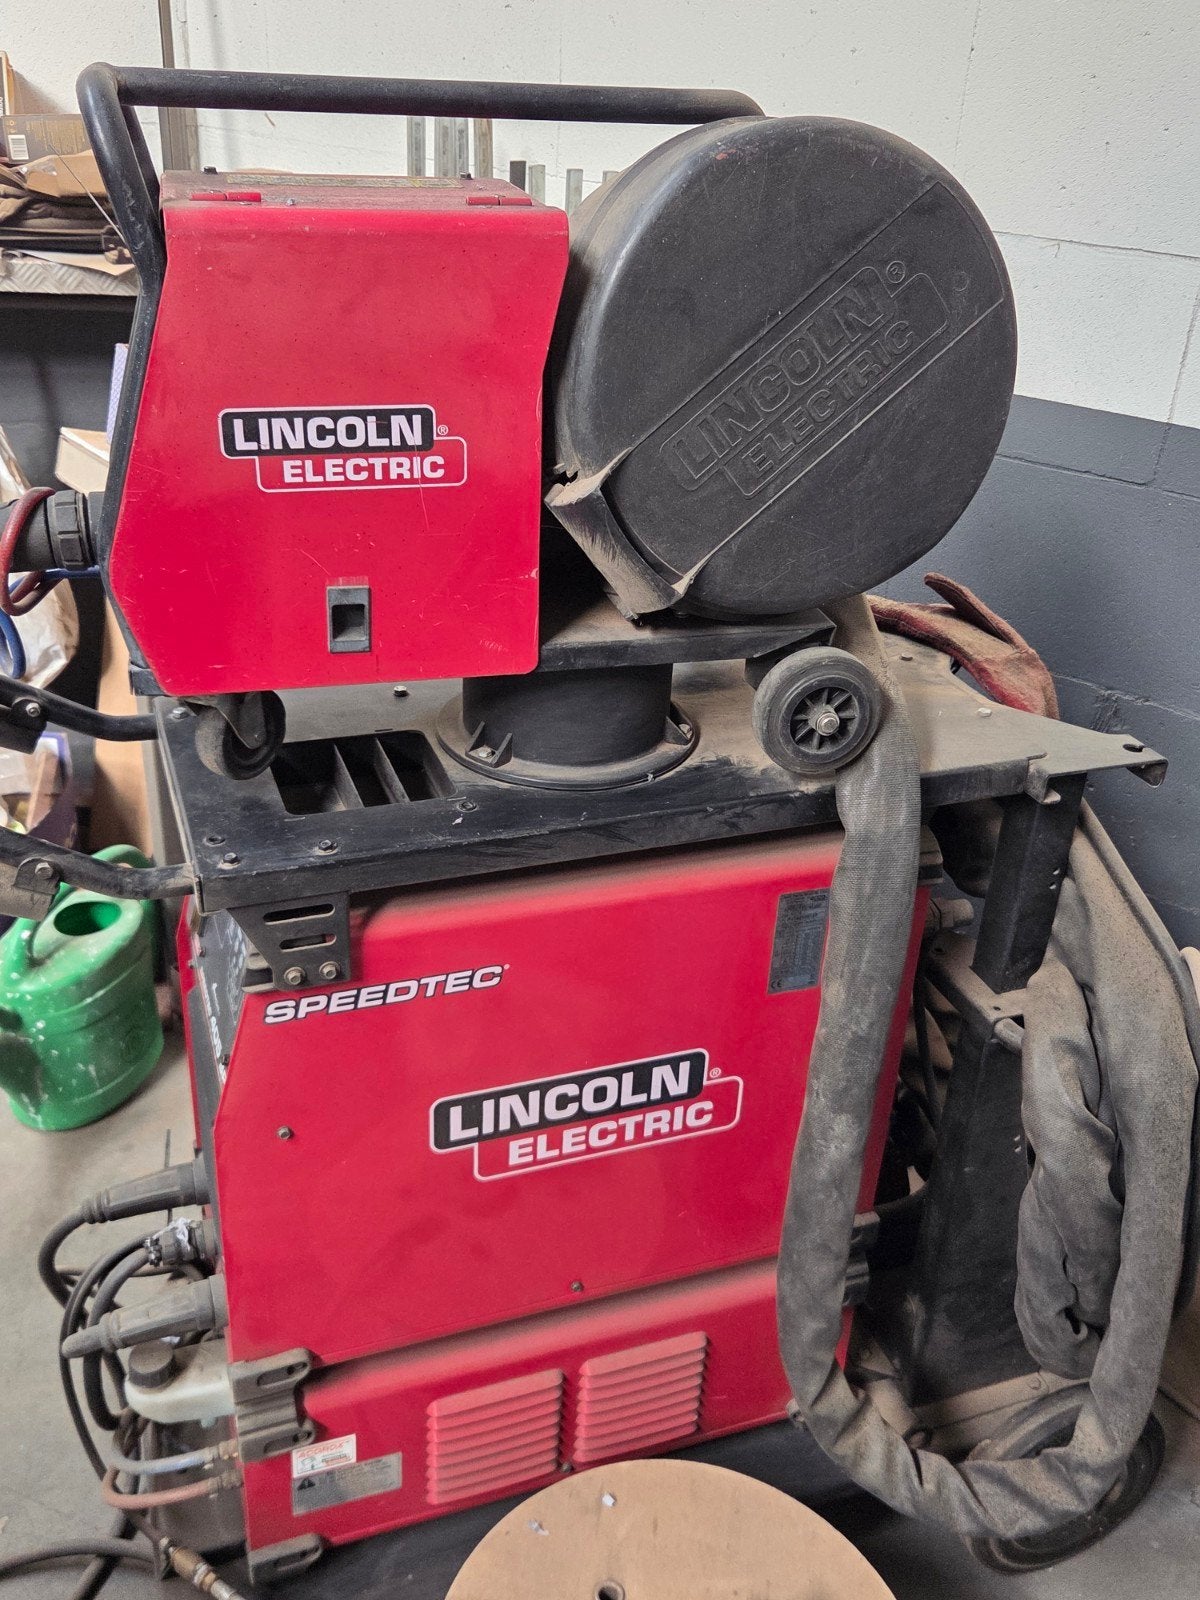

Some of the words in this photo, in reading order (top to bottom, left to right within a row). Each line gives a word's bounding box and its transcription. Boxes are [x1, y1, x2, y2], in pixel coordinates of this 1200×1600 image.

[671, 279, 887, 481] LINCOLN
[741, 320, 914, 478] ELECTRIC
[233, 414, 423, 451] LINCOLN
[282, 455, 446, 483] ELECTRIC
[263, 965, 504, 1025] SPEEDTEC
[449, 1060, 691, 1142] LINCOLN
[508, 1100, 714, 1166] ELECTRIC
